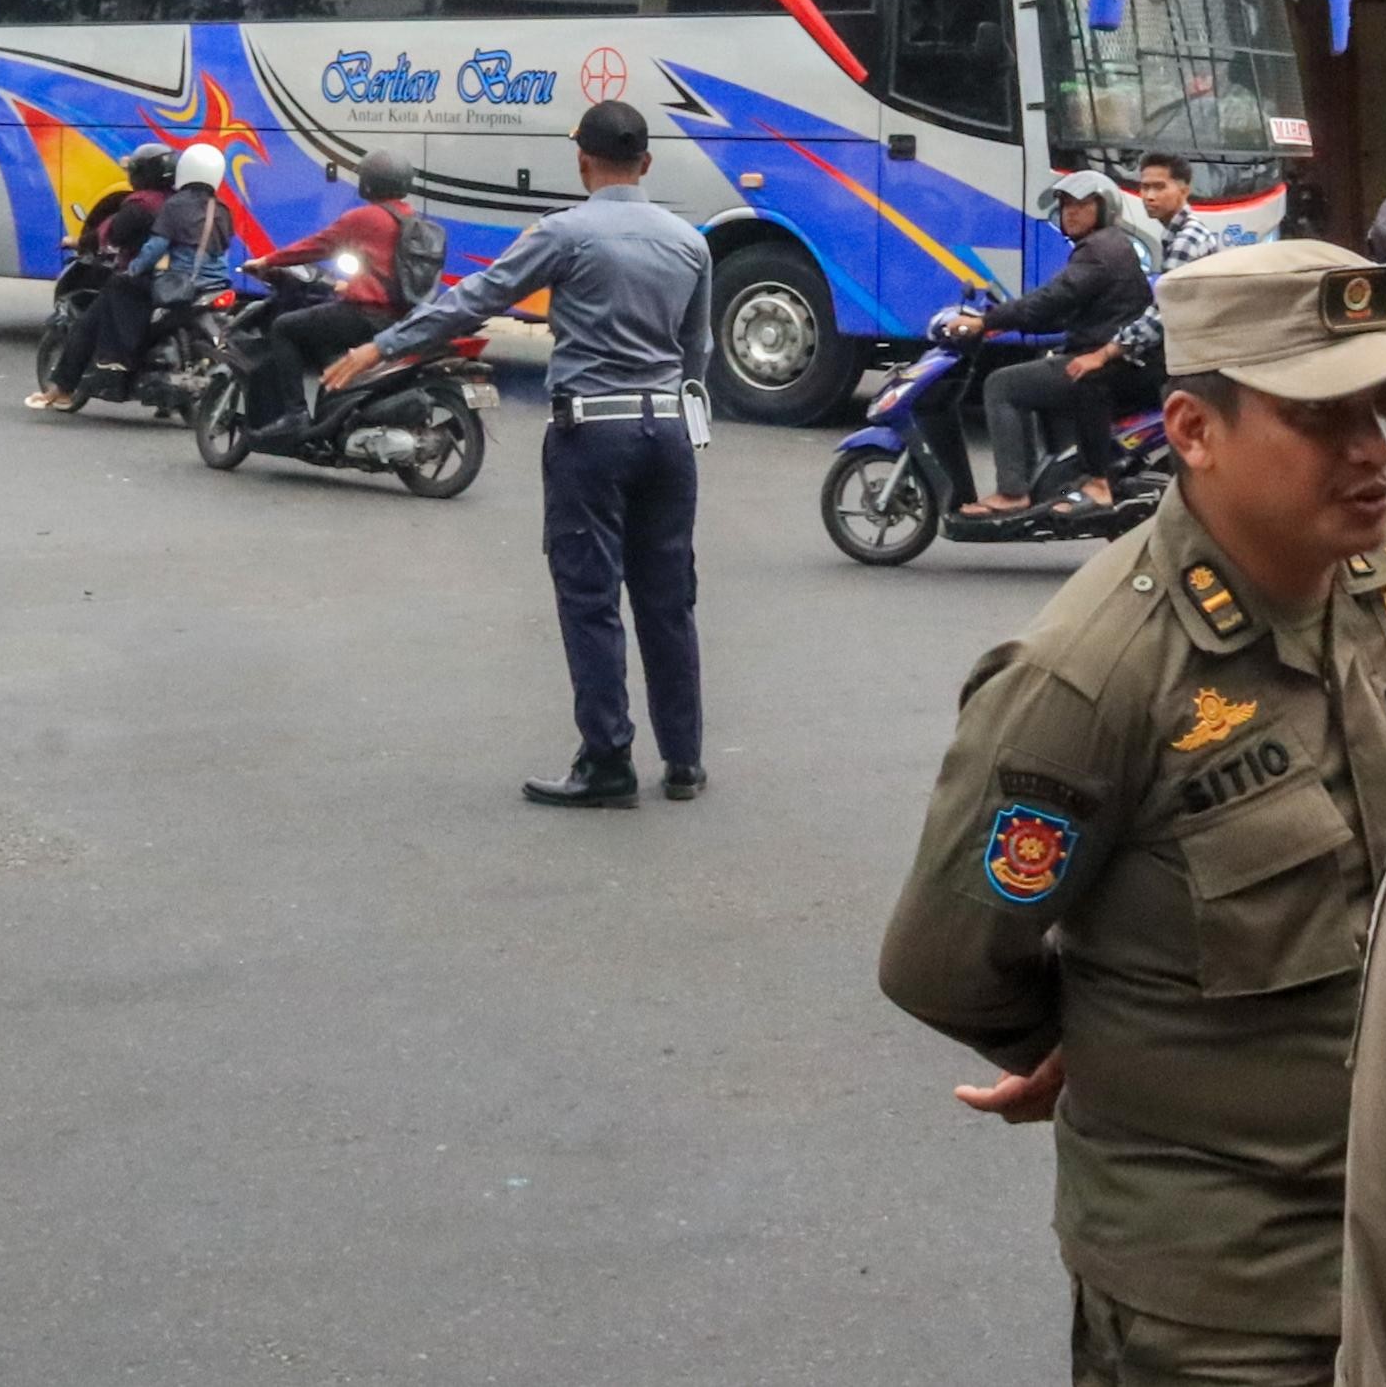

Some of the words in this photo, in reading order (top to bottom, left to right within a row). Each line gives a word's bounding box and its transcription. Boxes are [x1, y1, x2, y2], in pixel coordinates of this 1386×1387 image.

[321, 49, 441, 104] Berlian
[456, 48, 557, 104] Baru
[346, 107, 384, 123] Antar
[388, 108, 420, 123] Kota
[422, 109, 462, 124] Antar
[466, 108, 524, 128] Propinsi
